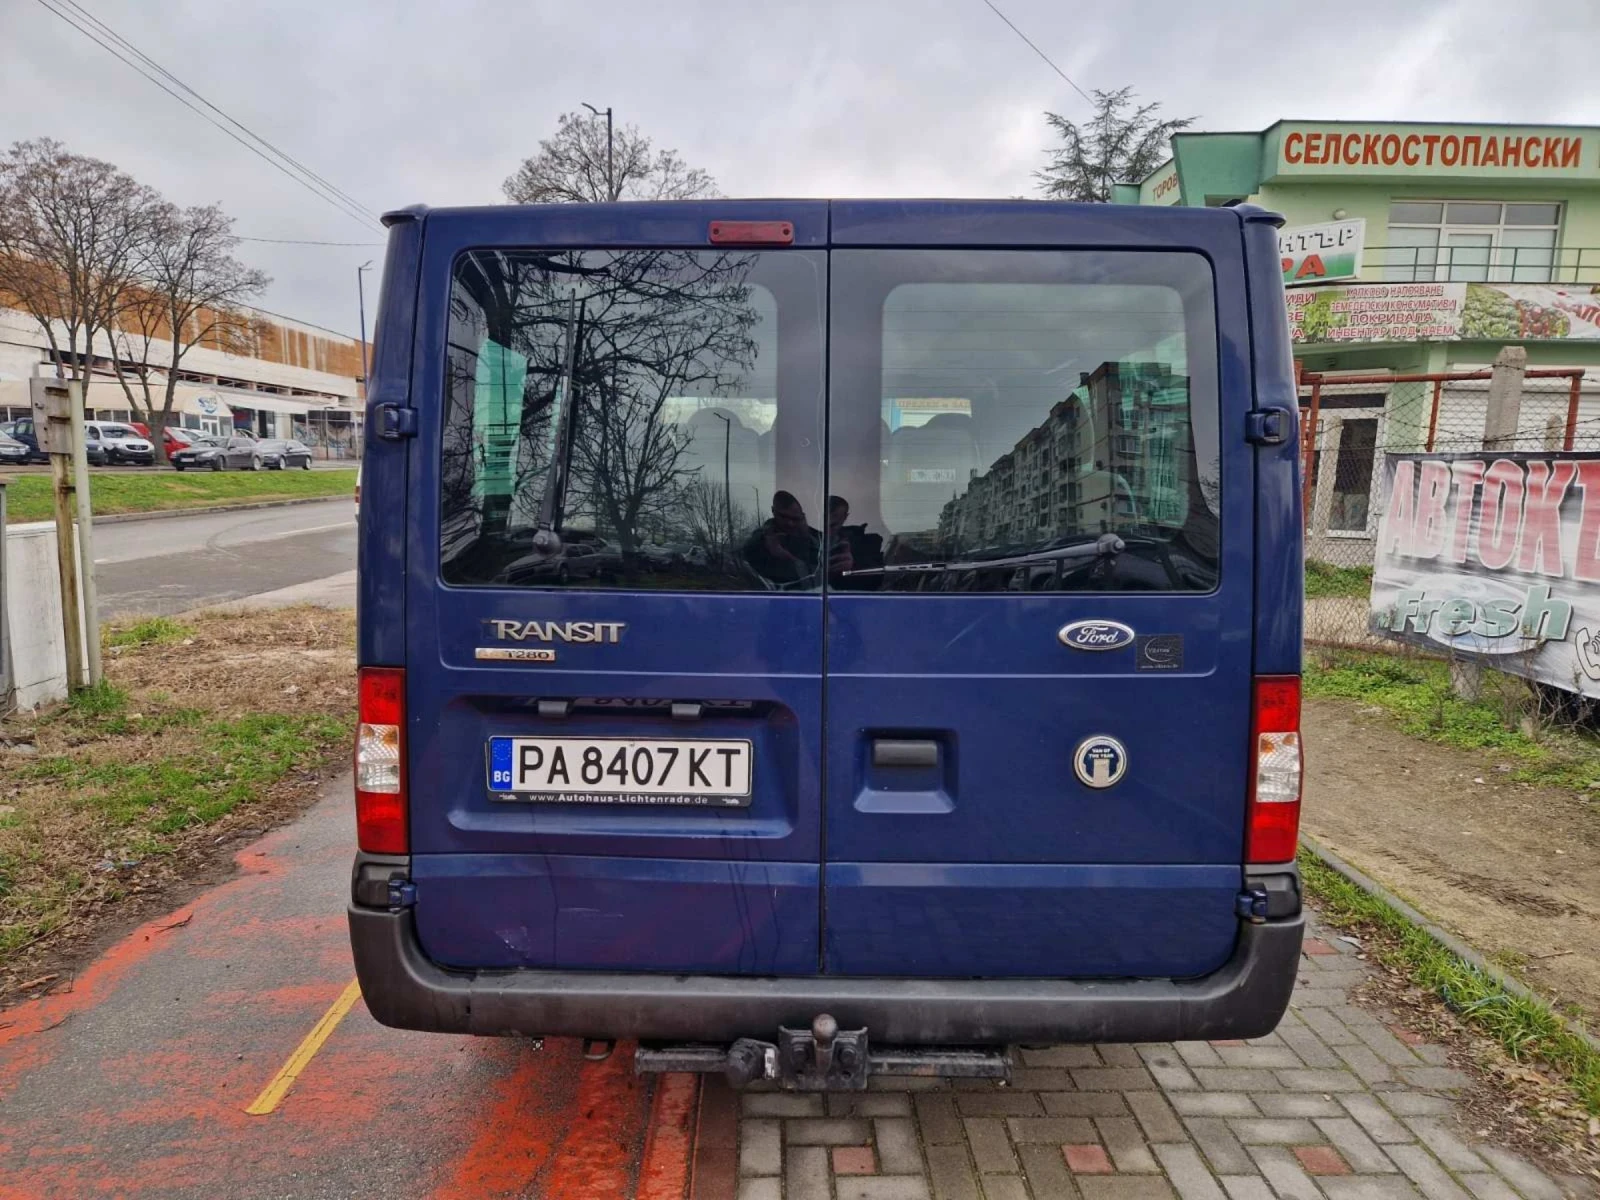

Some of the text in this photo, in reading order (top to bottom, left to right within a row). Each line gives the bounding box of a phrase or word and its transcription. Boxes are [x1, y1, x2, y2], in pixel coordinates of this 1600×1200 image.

[1284, 132, 1583, 168] СЕЛСКОСТОПАНСКИ
[1350, 312, 1433, 324] ПОКРИВАЛА
[1327, 326, 1454, 338] ИНВЕНТАР ПОД НАЕМ
[1076, 625, 1119, 644] Ford
[519, 745, 741, 788] PA 8407 KT
[493, 771, 511, 783] BG
[529, 793, 708, 804] www.Autohaus-Lichtenrade.de
